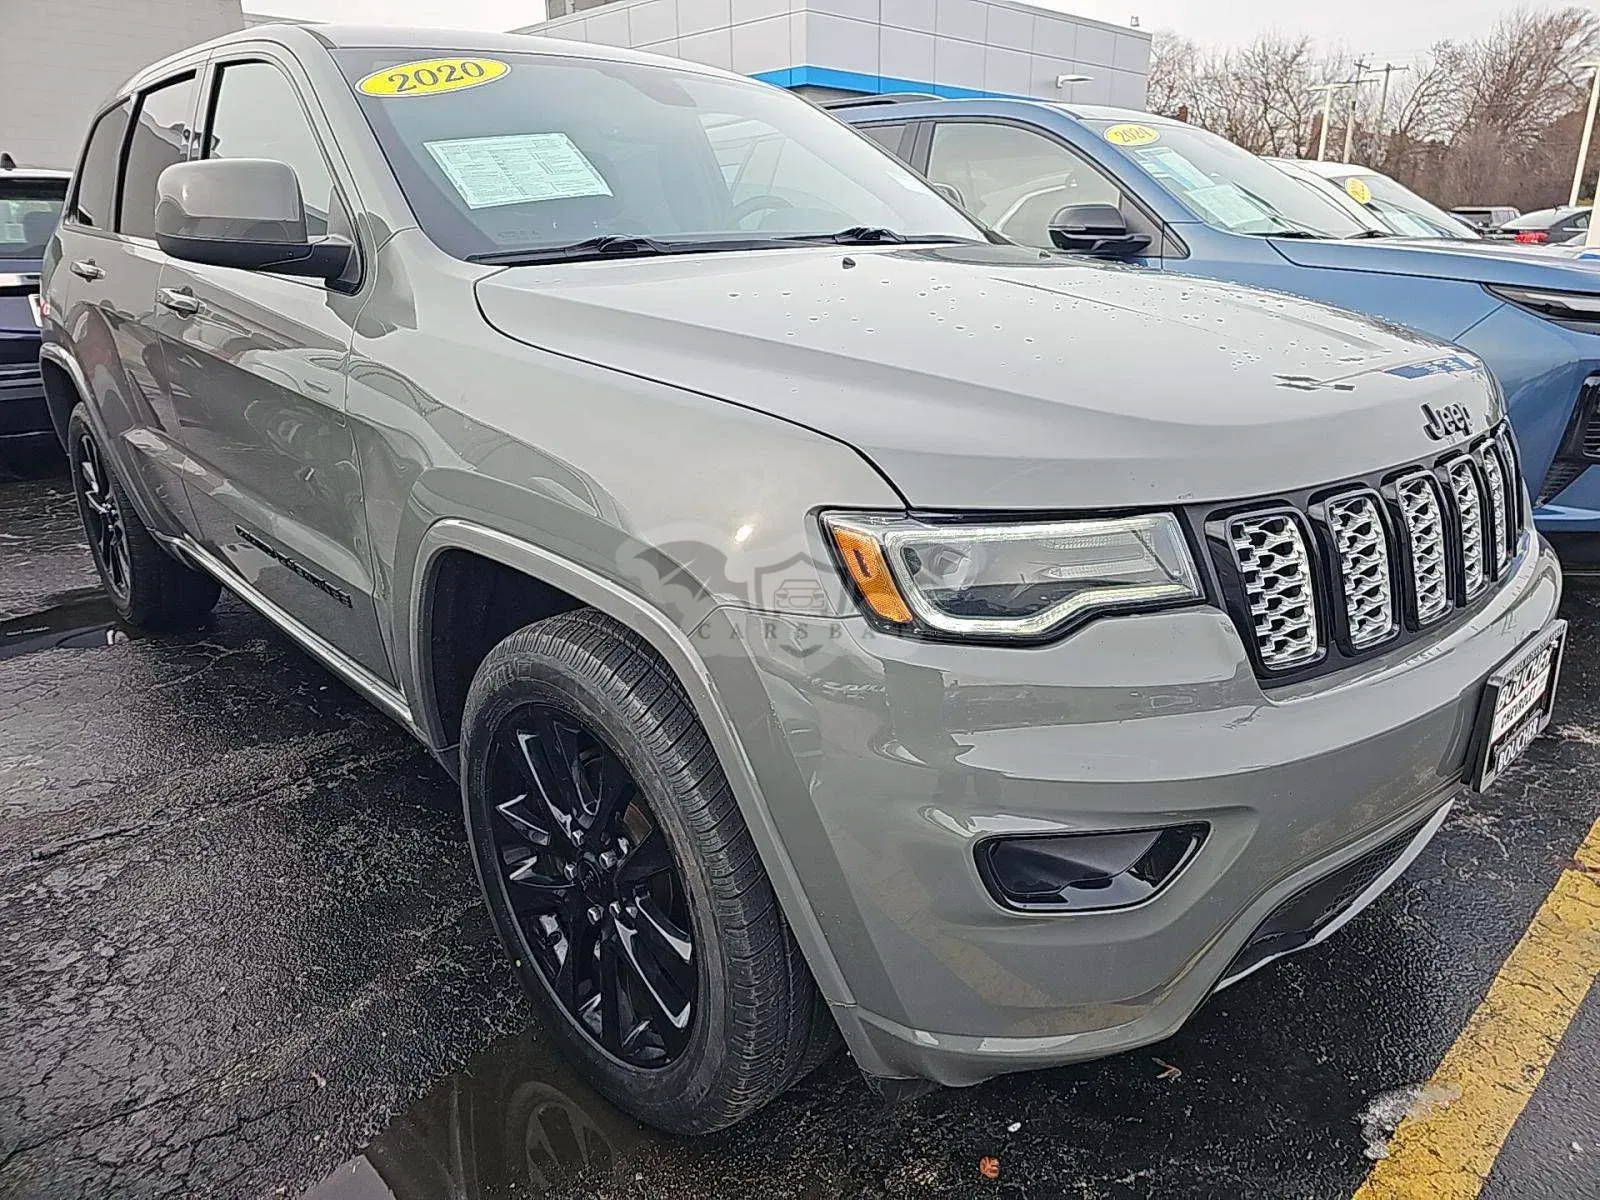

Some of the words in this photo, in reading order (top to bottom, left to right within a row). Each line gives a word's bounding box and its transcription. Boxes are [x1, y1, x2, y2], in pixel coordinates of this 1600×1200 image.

[388, 61, 485, 92] 2020
[1421, 403, 1473, 441] Jeep
[1497, 648, 1553, 713] BOUCHER
[1497, 717, 1539, 773] BOUCHER
